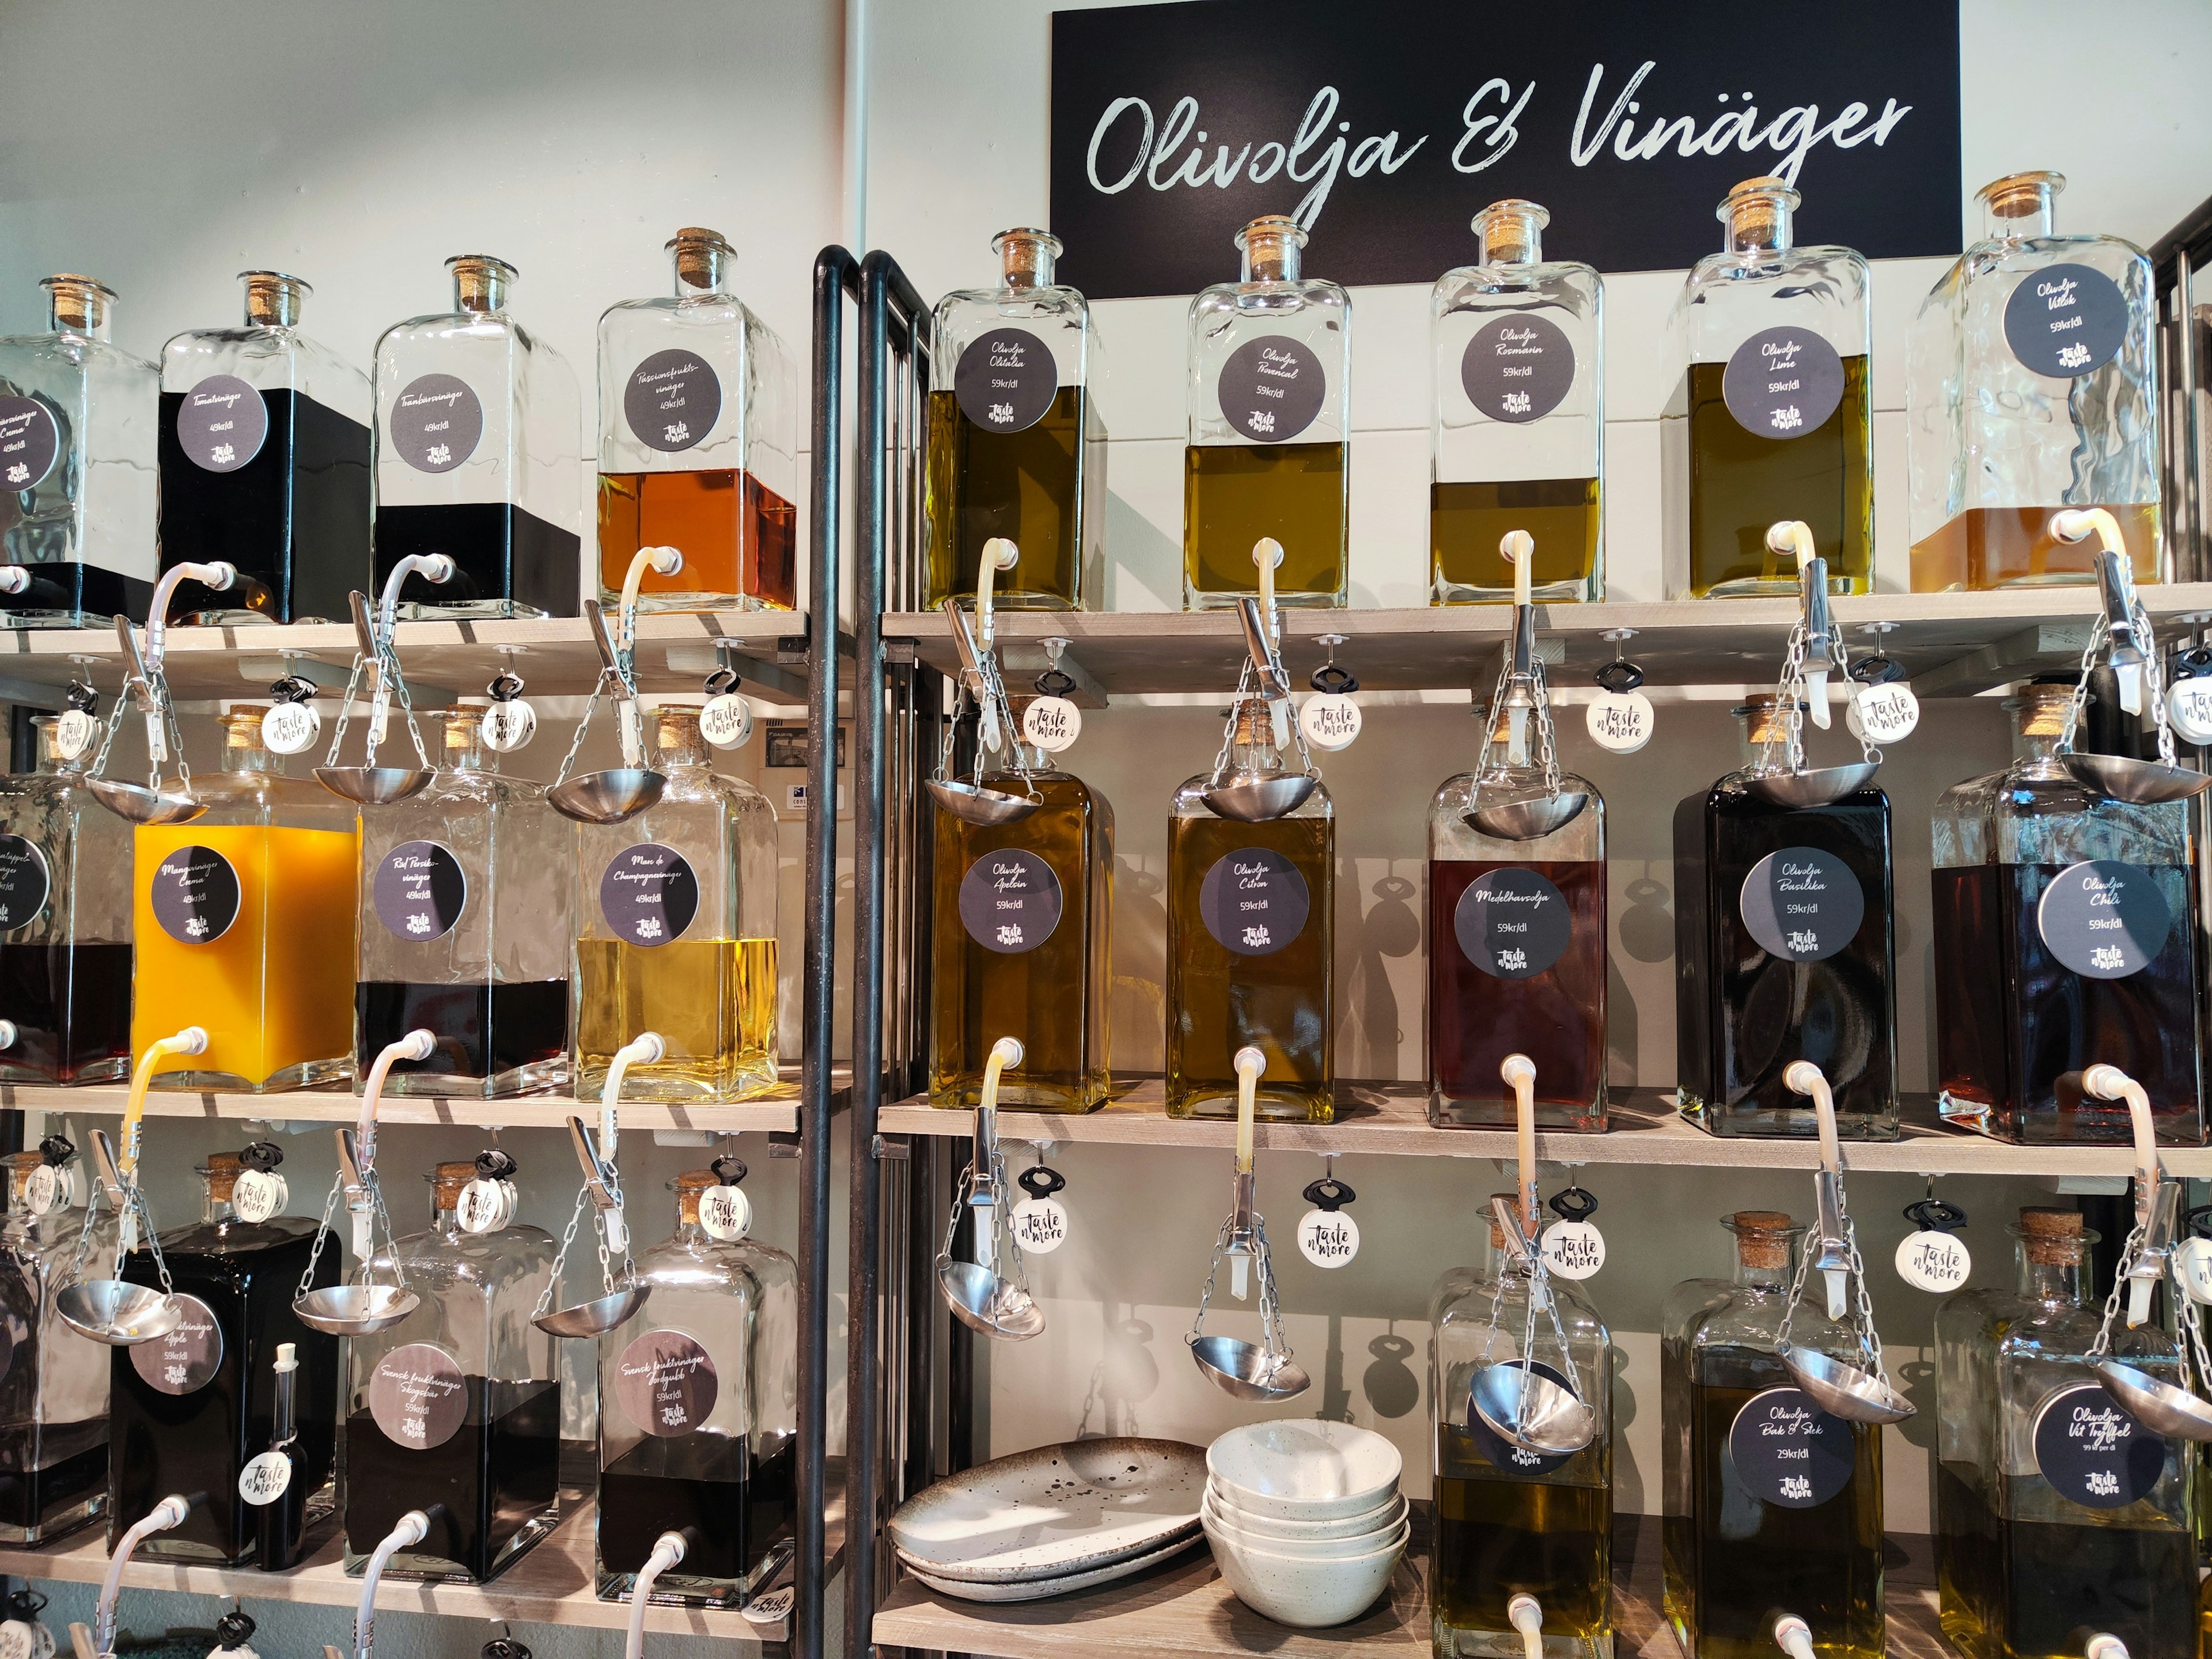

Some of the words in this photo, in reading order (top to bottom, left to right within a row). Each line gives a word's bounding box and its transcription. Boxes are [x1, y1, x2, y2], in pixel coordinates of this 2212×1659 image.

[1087, 85, 1428, 228] Olivolja
[1452, 77, 1536, 173] &
[1570, 60, 1912, 188] Vinäger
[2037, 278, 2078, 298] Olivolja
[2050, 316, 2082, 333] 59kr/dl
[1500, 328, 1539, 346] Olivolja
[991, 342, 1025, 359] Olivolja
[1495, 344, 1543, 356] Rosmarin
[1762, 341, 1802, 360] Olivolja
[990, 356, 1025, 368] Olitalia
[1263, 348, 1298, 369] Olivolja
[1770, 358, 1796, 372] Lime
[1503, 366, 1532, 377] 59kr/dl
[656, 382, 684, 398] vinäger
[991, 379, 1017, 389] 59kr/dl
[1768, 380, 1800, 393] 59kr/dl
[1256, 385, 1284, 398] 59kr/dl
[194, 393, 241, 408] Tomatvinäger
[402, 391, 463, 407] Tranbärsvinäger
[660, 397, 685, 410] 49kr/dl
[1, 427, 25, 438] Crema
[210, 421, 233, 431] 49kr/dl
[425, 421, 449, 431] 49kr/dl
[3, 440, 25, 453] 49kr/dl
[162, 862, 217, 877] Mangovinäger
[993, 863, 1027, 881] Olivolja
[1234, 862, 1270, 880] Olivolja
[1782, 863, 1823, 884] Olivolja
[403, 874, 431, 889] vinäger
[994, 878, 1027, 893] Apelsin
[1239, 878, 1268, 889] Citron
[1777, 878, 1827, 892] Basilika
[2082, 877, 2126, 896] Olivolja
[183, 893, 206, 904] 49kr/dl
[406, 889, 430, 900] 49kr/dl
[635, 893, 661, 903] 49kr/dl
[1475, 889, 1550, 909] Medelhavsolja
[2090, 893, 2121, 906] Chili
[997, 900, 1022, 910] 59kr/dl
[1240, 900, 1268, 910] 59kr/dl
[1787, 904, 1818, 914] 59kr/dl
[1497, 923, 1527, 933] 59kr/dl
[2089, 918, 2122, 929] 59kr/dl
[165, 1351, 187, 1361] 59kr/dl
[621, 1363, 652, 1377] Svensk
[653, 1356, 704, 1373] fruktvinäger
[381, 1365, 409, 1381] Svensk
[410, 1370, 461, 1391] fruktvinäger
[646, 1368, 685, 1391] Jordgubb
[400, 1381, 439, 1403] Skogsbär
[657, 1389, 681, 1402] 59kr/dl
[405, 1403, 430, 1415] 59kr/dl
[1770, 1407, 1811, 1426] Olivolja
[2073, 1407, 2123, 1430] Olivolja
[1759, 1422, 1786, 1436] Bak
[1787, 1423, 1796, 1435] &
[1801, 1422, 1823, 1435] Stek
[2069, 1422, 2086, 1437] Vit
[2088, 1422, 2131, 1446] Tryffel
[1777, 1449, 1808, 1459] 29kr/dl
